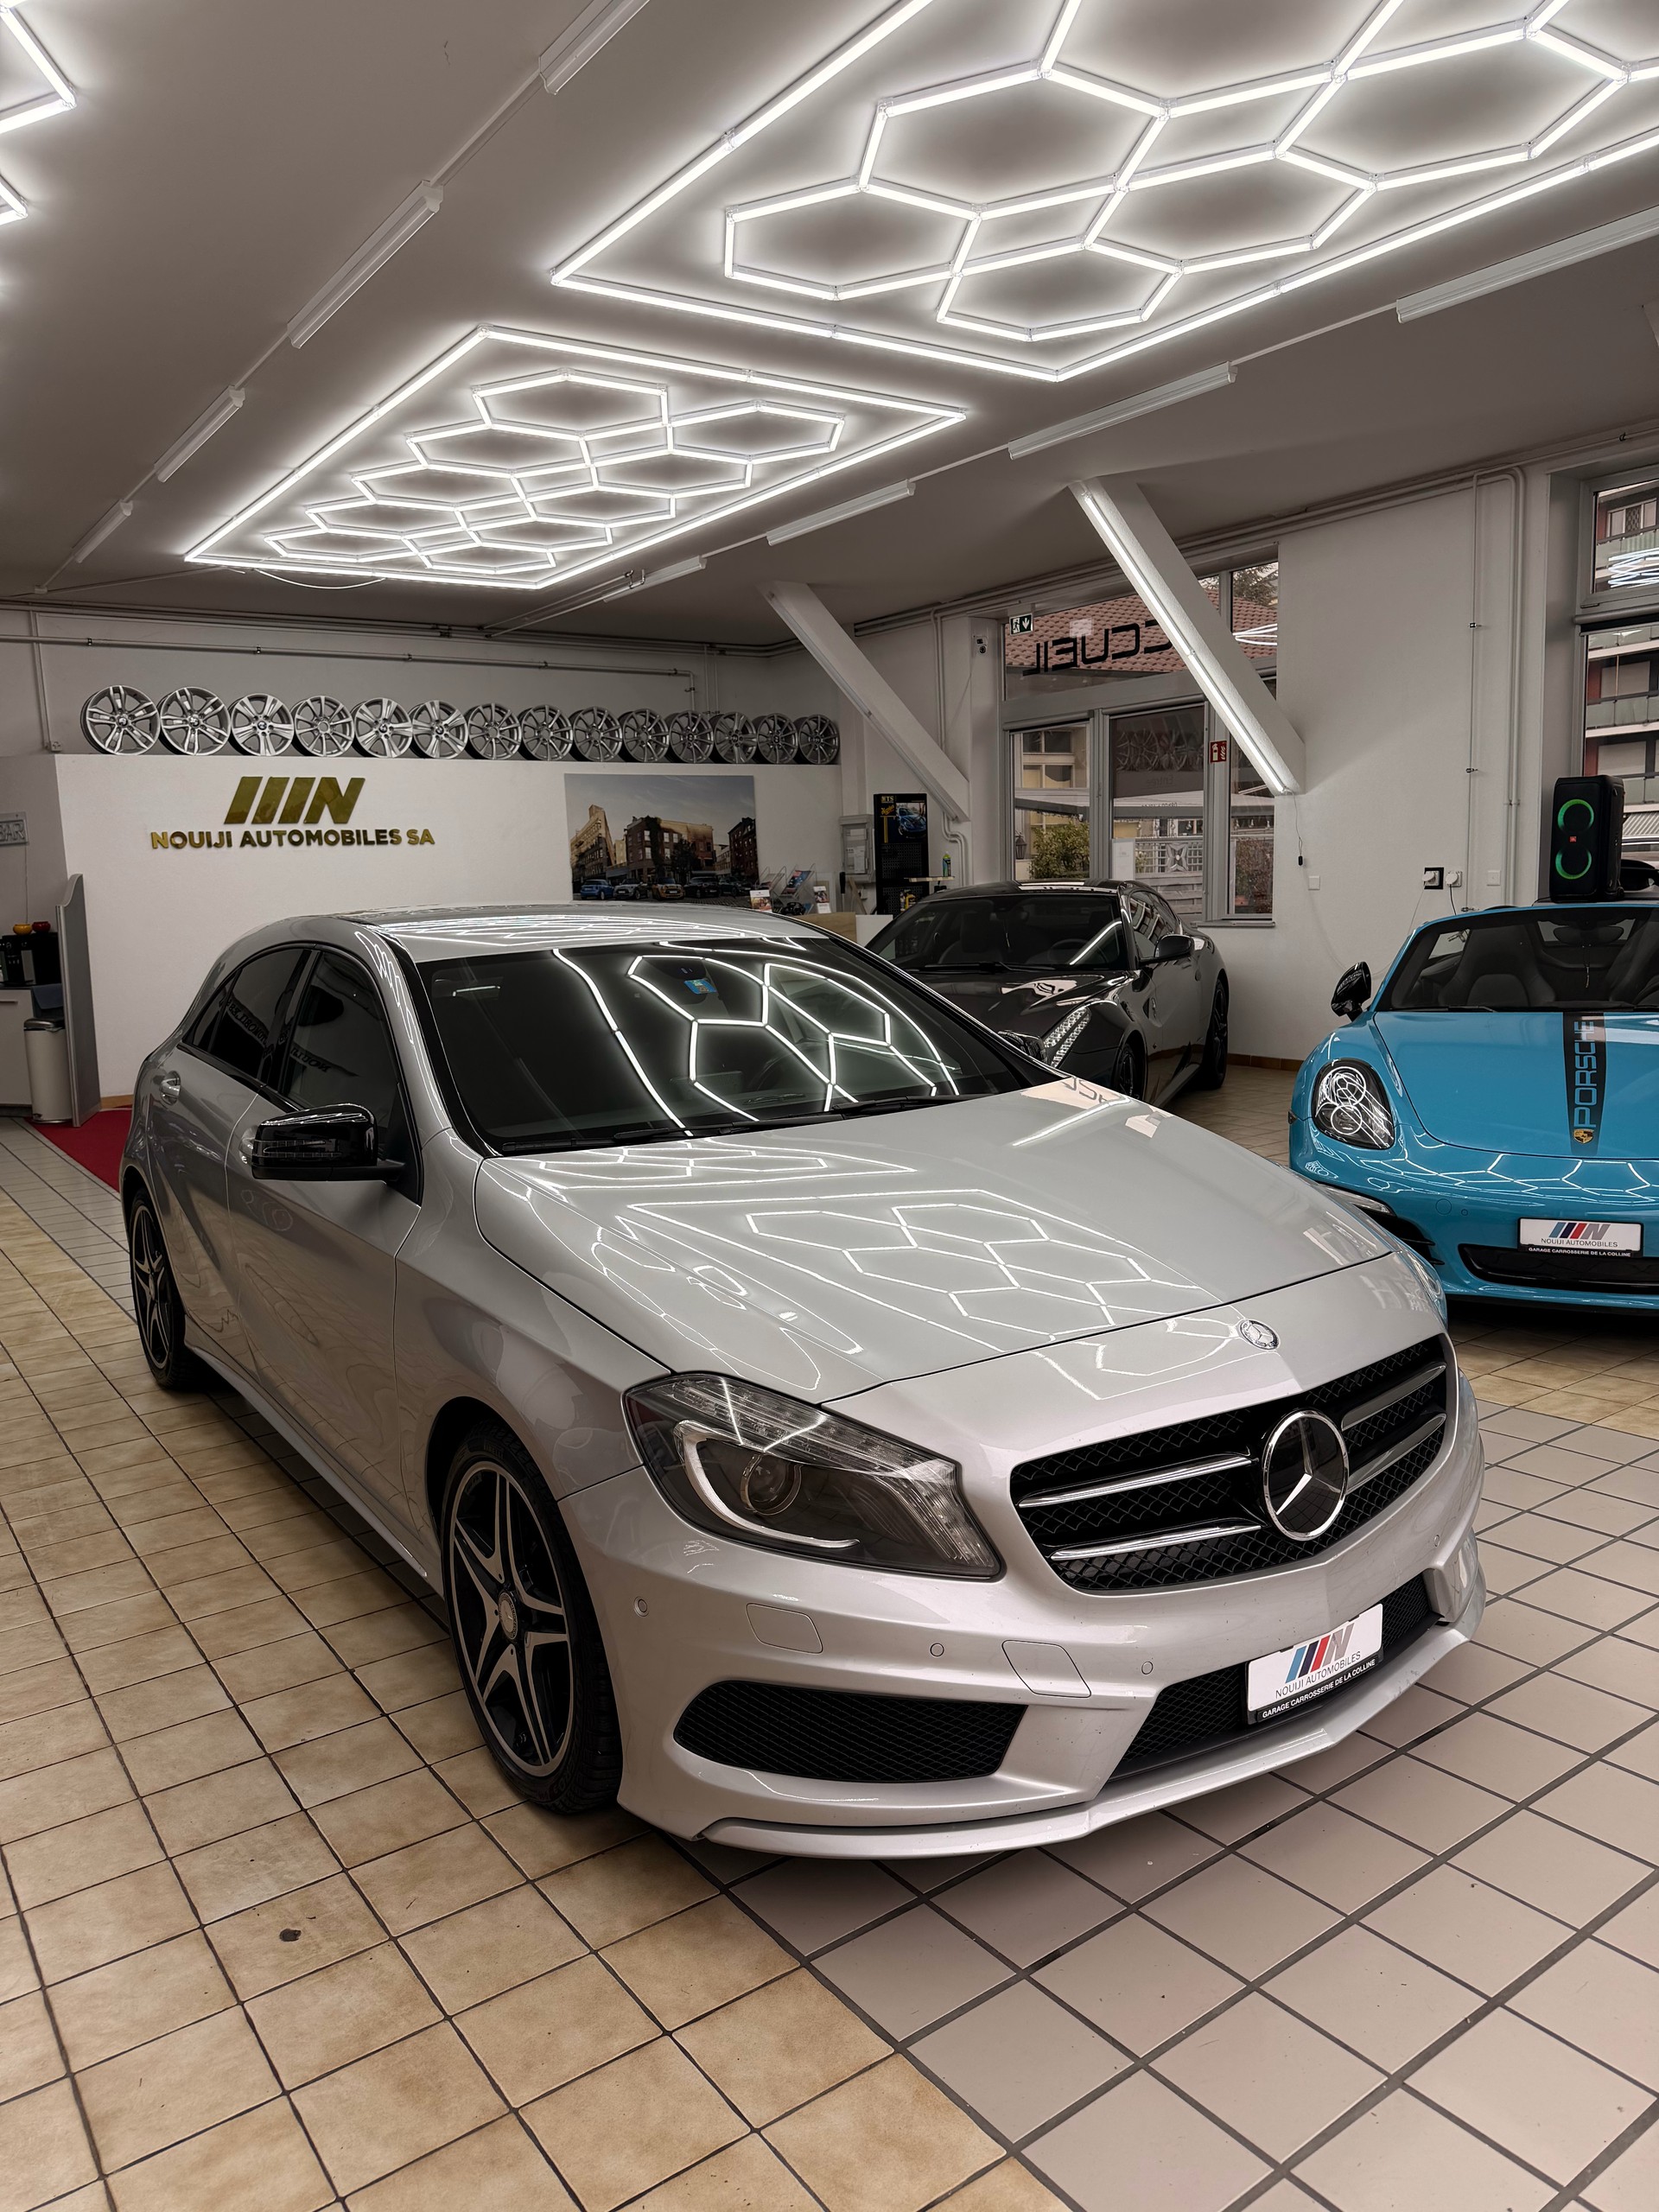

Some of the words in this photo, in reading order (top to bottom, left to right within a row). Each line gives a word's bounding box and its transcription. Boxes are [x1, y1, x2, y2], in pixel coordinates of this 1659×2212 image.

[150, 830, 232, 849] NOUIJI
[239, 829, 402, 848] AUTOMOBILES
[406, 829, 435, 845] SA
[1574, 1021, 1597, 1128] PORSCHE
[1262, 1702, 1289, 1718] GARAGE
[1290, 1681, 1334, 1707] CARROSSERIE
[1334, 1676, 1344, 1687] DE
[1344, 1671, 1351, 1681] LA
[1351, 1658, 1376, 1676] COLLINE
[1275, 1679, 1304, 1699] NOUIJI
[1306, 1650, 1361, 1686] AUTOMOBILES
